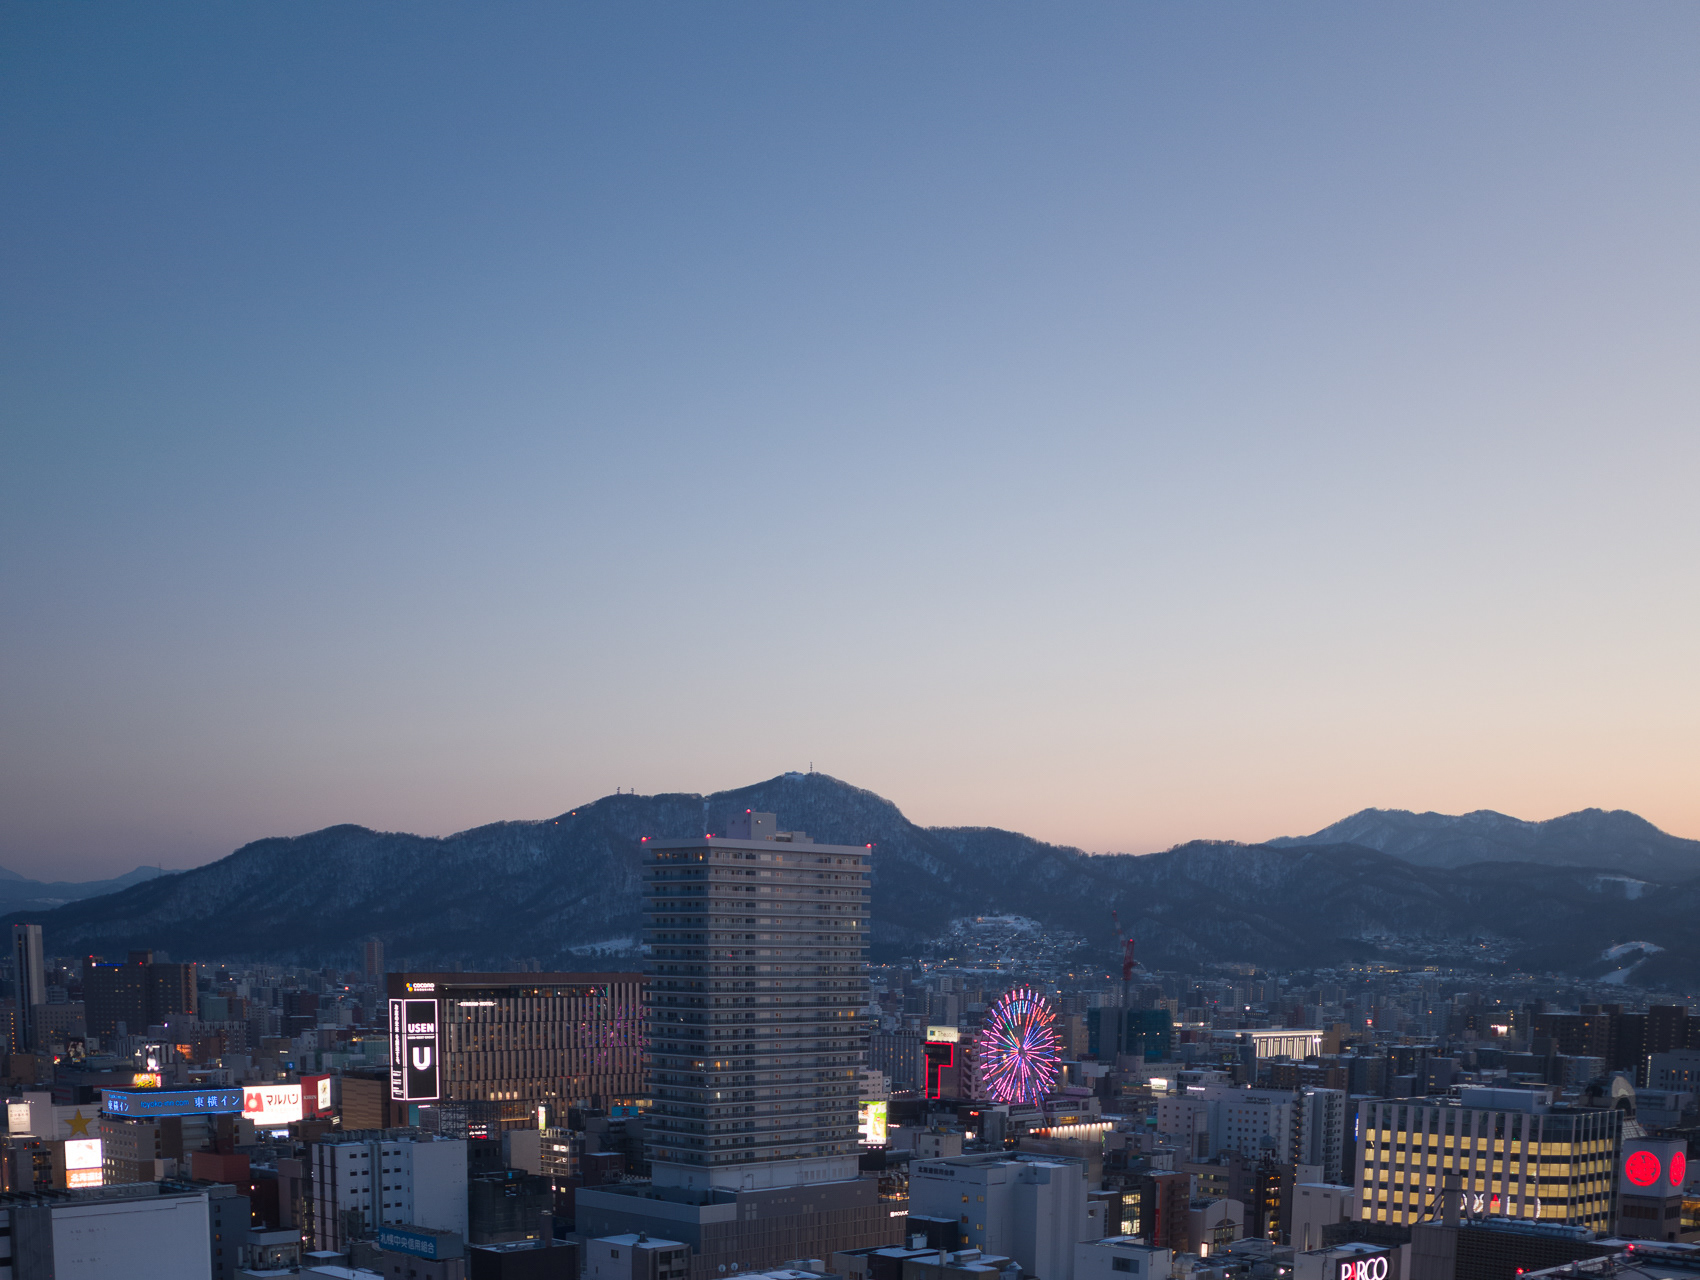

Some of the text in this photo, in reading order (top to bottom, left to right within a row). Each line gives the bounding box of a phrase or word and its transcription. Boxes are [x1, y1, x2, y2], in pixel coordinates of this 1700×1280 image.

[407, 1023, 435, 1033] USEN
[412, 1047, 431, 1070] U
[108, 1100, 129, 1111] 東横イン
[194, 1095, 240, 1108] 東横イン
[266, 1093, 299, 1106] マルハン
[380, 1232, 435, 1254] 札幌中央信用組合
